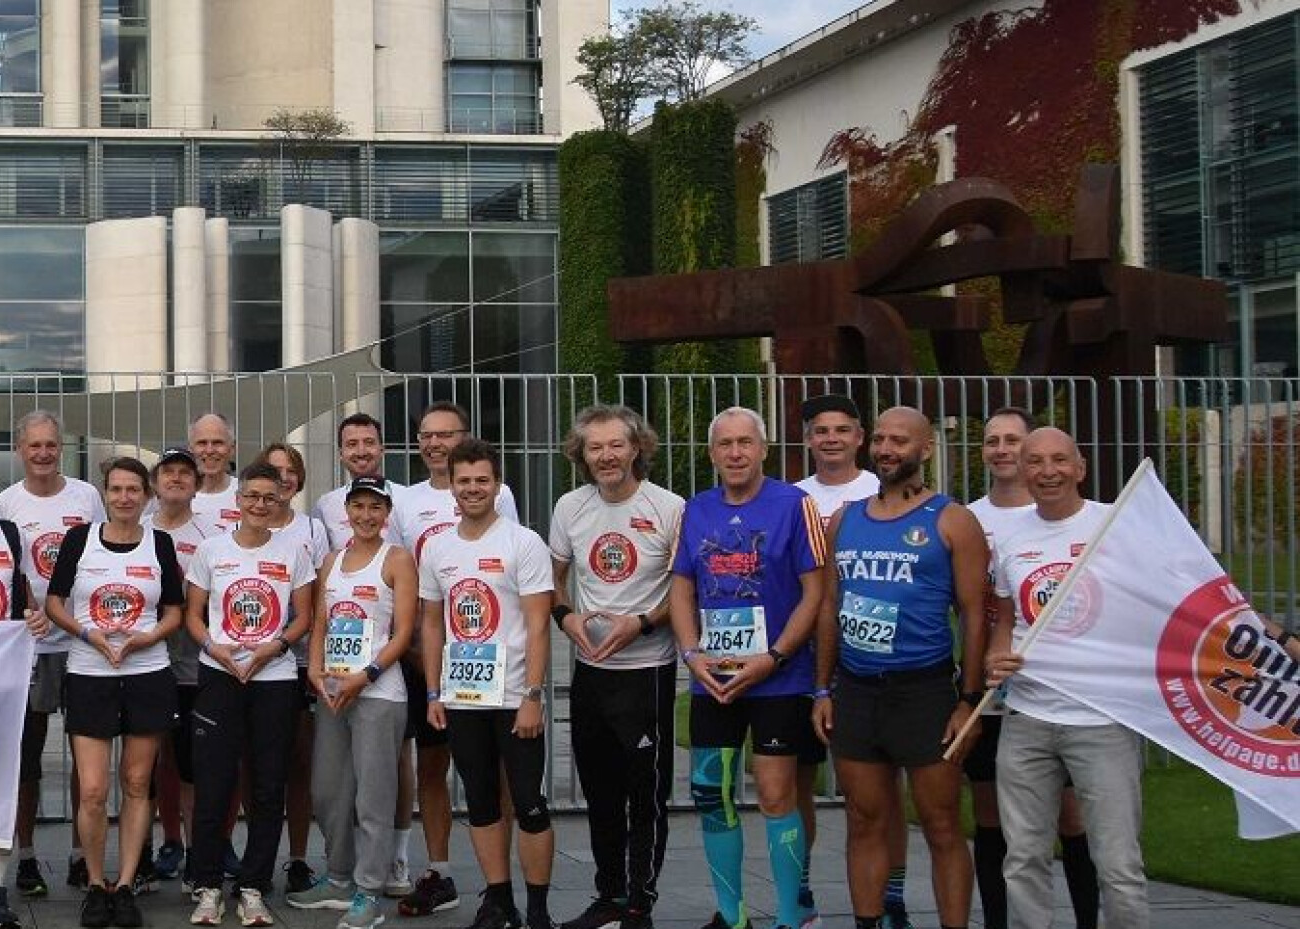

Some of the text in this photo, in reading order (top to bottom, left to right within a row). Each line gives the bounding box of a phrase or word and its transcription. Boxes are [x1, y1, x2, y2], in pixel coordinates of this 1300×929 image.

[449, 662, 495, 682] 23923
[1224, 624, 1300, 685] Om
[1166, 677, 1300, 774] www.helpage.d
